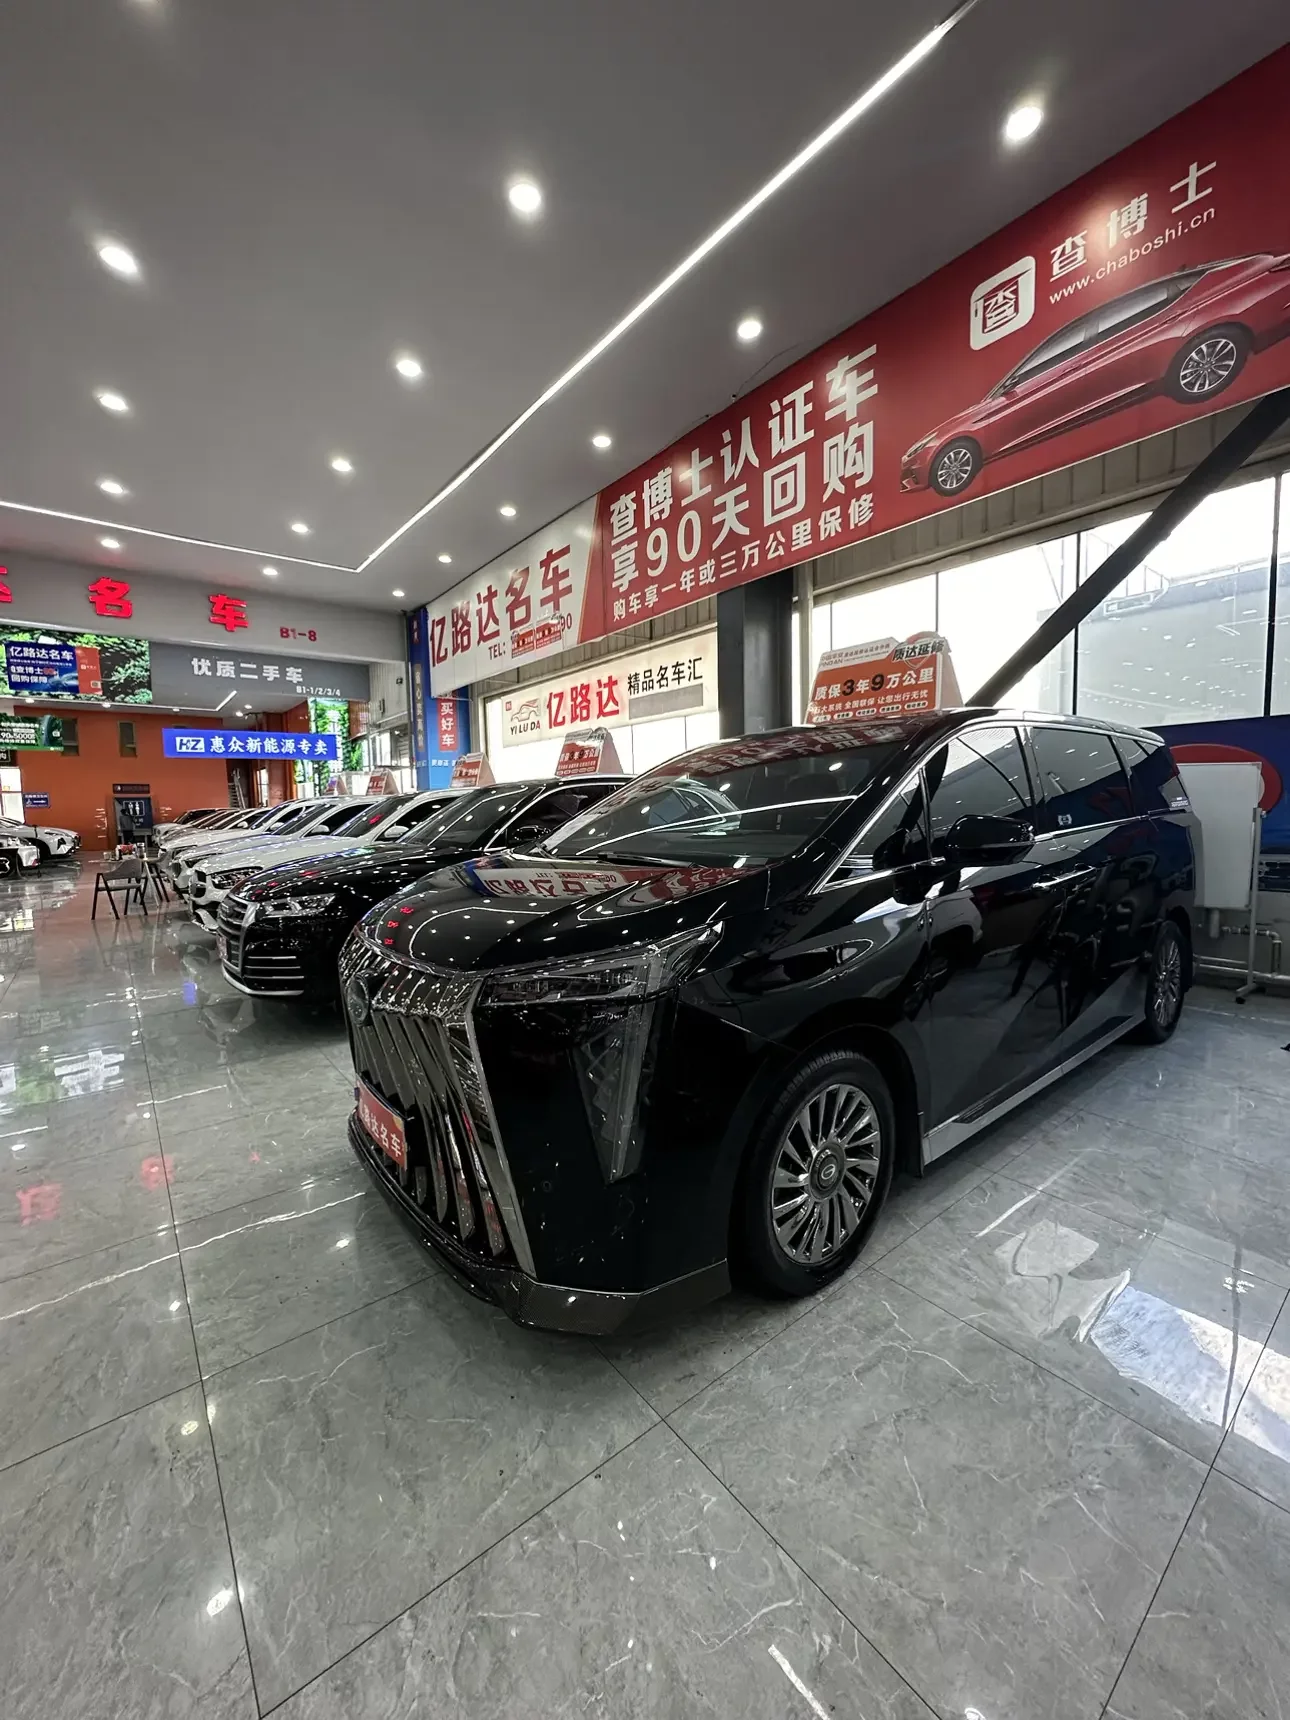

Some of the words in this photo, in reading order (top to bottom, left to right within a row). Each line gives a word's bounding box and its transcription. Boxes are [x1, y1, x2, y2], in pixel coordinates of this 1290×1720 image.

[1050, 161, 1217, 282] 查博士
[1049, 206, 1216, 305] www.chaboshi.cn
[610, 344, 878, 542] 查博士认证车
[611, 421, 875, 594] 享90天回购
[613, 494, 875, 622] 购车享一年或三万公里保修
[430, 543, 573, 668] 亿路达名车
[10, 646, 74, 661] 亿路达名车
[280, 626, 318, 643] B1-8
[191, 657, 304, 684] 优质二手车
[627, 656, 703, 697] 精品名车汇
[814, 667, 934, 701] 质保3年9万公里
[546, 675, 620, 729] 亿路达
[209, 735, 329, 756] 惠众新能源专卖
